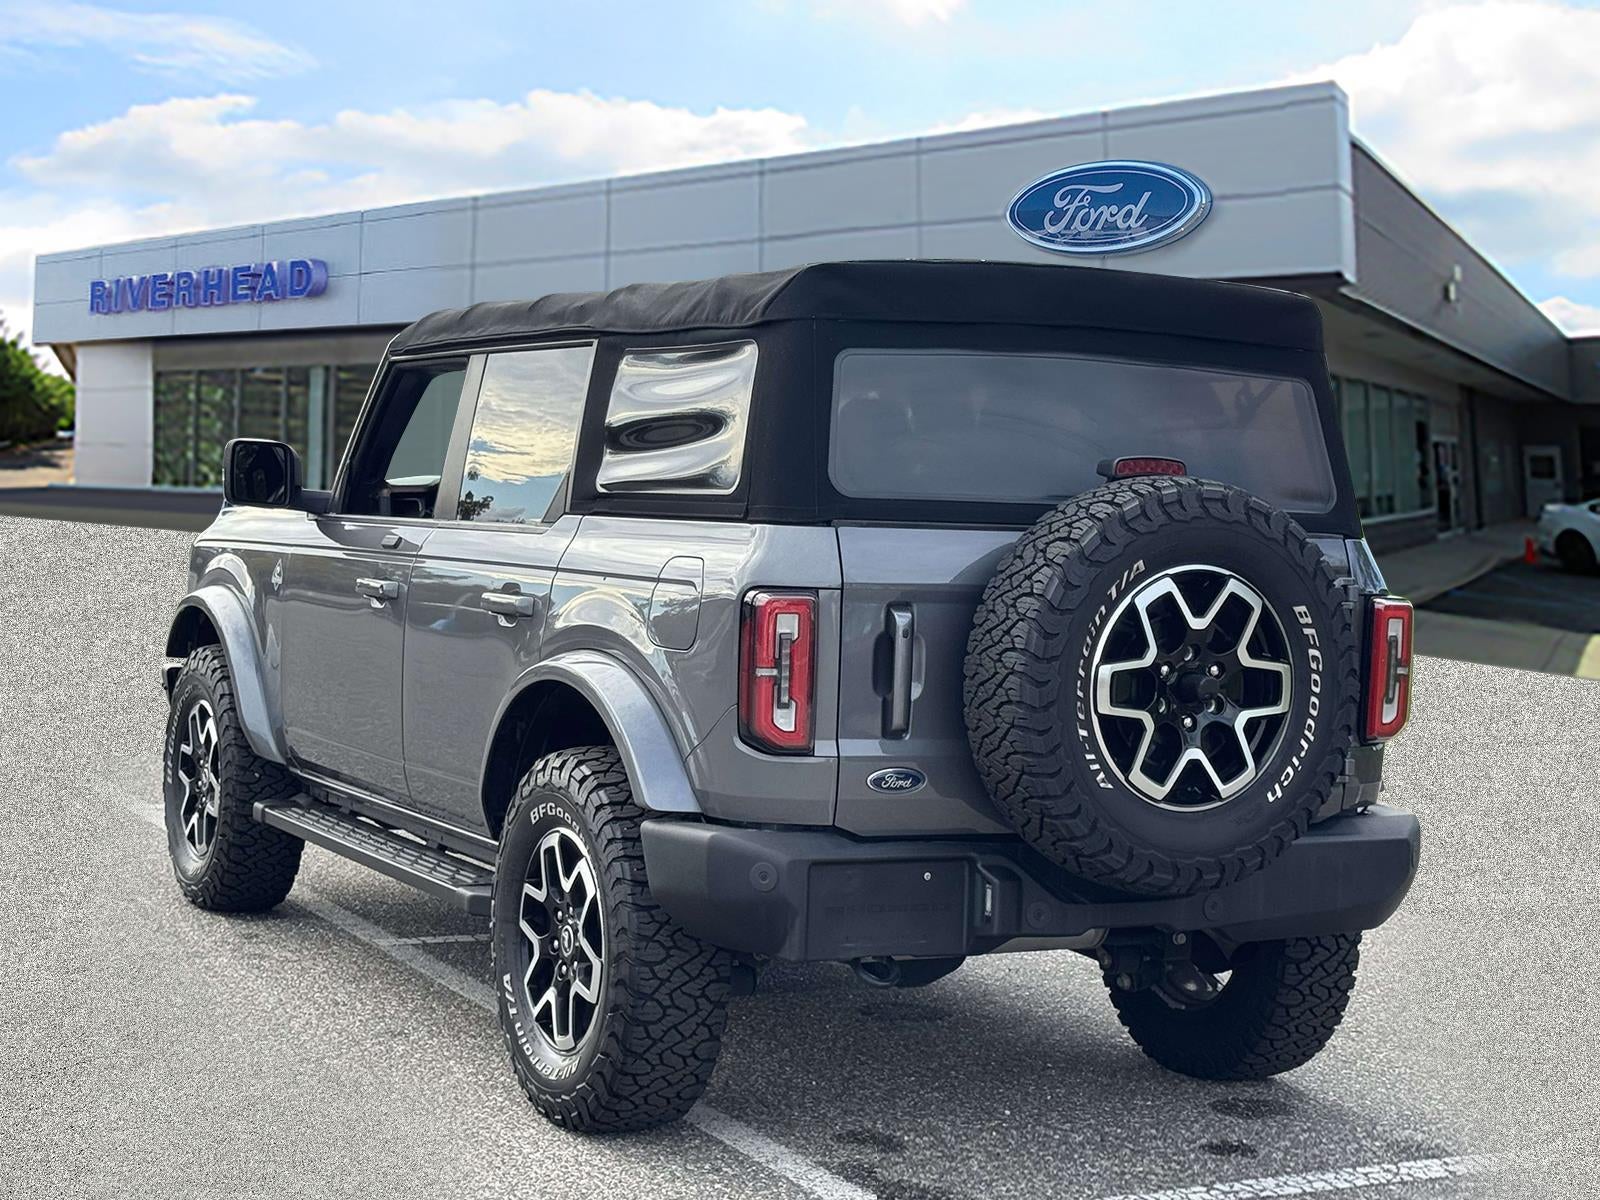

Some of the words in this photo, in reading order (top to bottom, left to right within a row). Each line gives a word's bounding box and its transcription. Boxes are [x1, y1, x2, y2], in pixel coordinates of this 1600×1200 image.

[1044, 183, 1152, 233] Ford
[88, 258, 327, 315] RIVERHEAD
[1076, 605, 1114, 790] All-Terrain
[1107, 559, 1146, 600] T/A
[1266, 605, 1323, 803] BFGoodrich
[881, 773, 913, 788] Ford
[503, 973, 517, 1019] T/A
